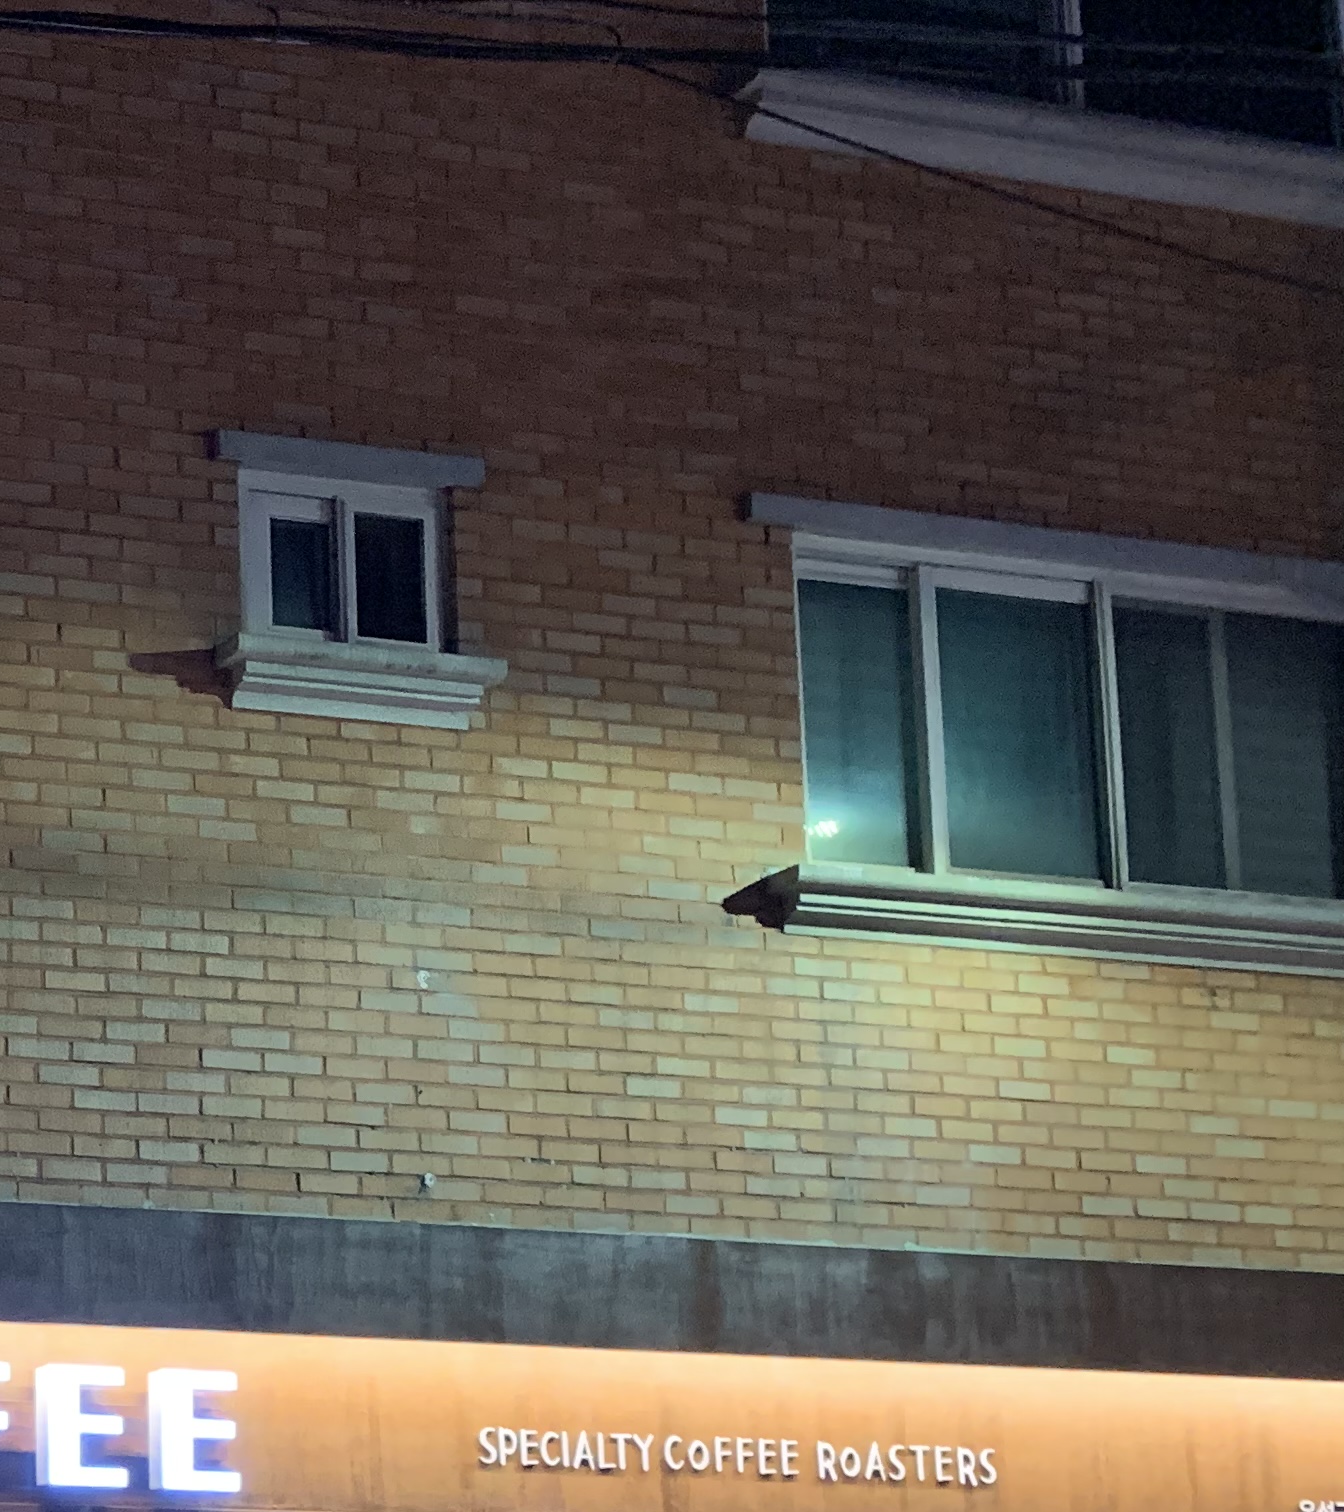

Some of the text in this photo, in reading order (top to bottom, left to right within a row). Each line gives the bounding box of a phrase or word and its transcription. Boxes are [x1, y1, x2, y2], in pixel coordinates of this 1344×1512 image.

[478, 1425, 997, 1487] SPECIALTY COFFEE ROASTERS
